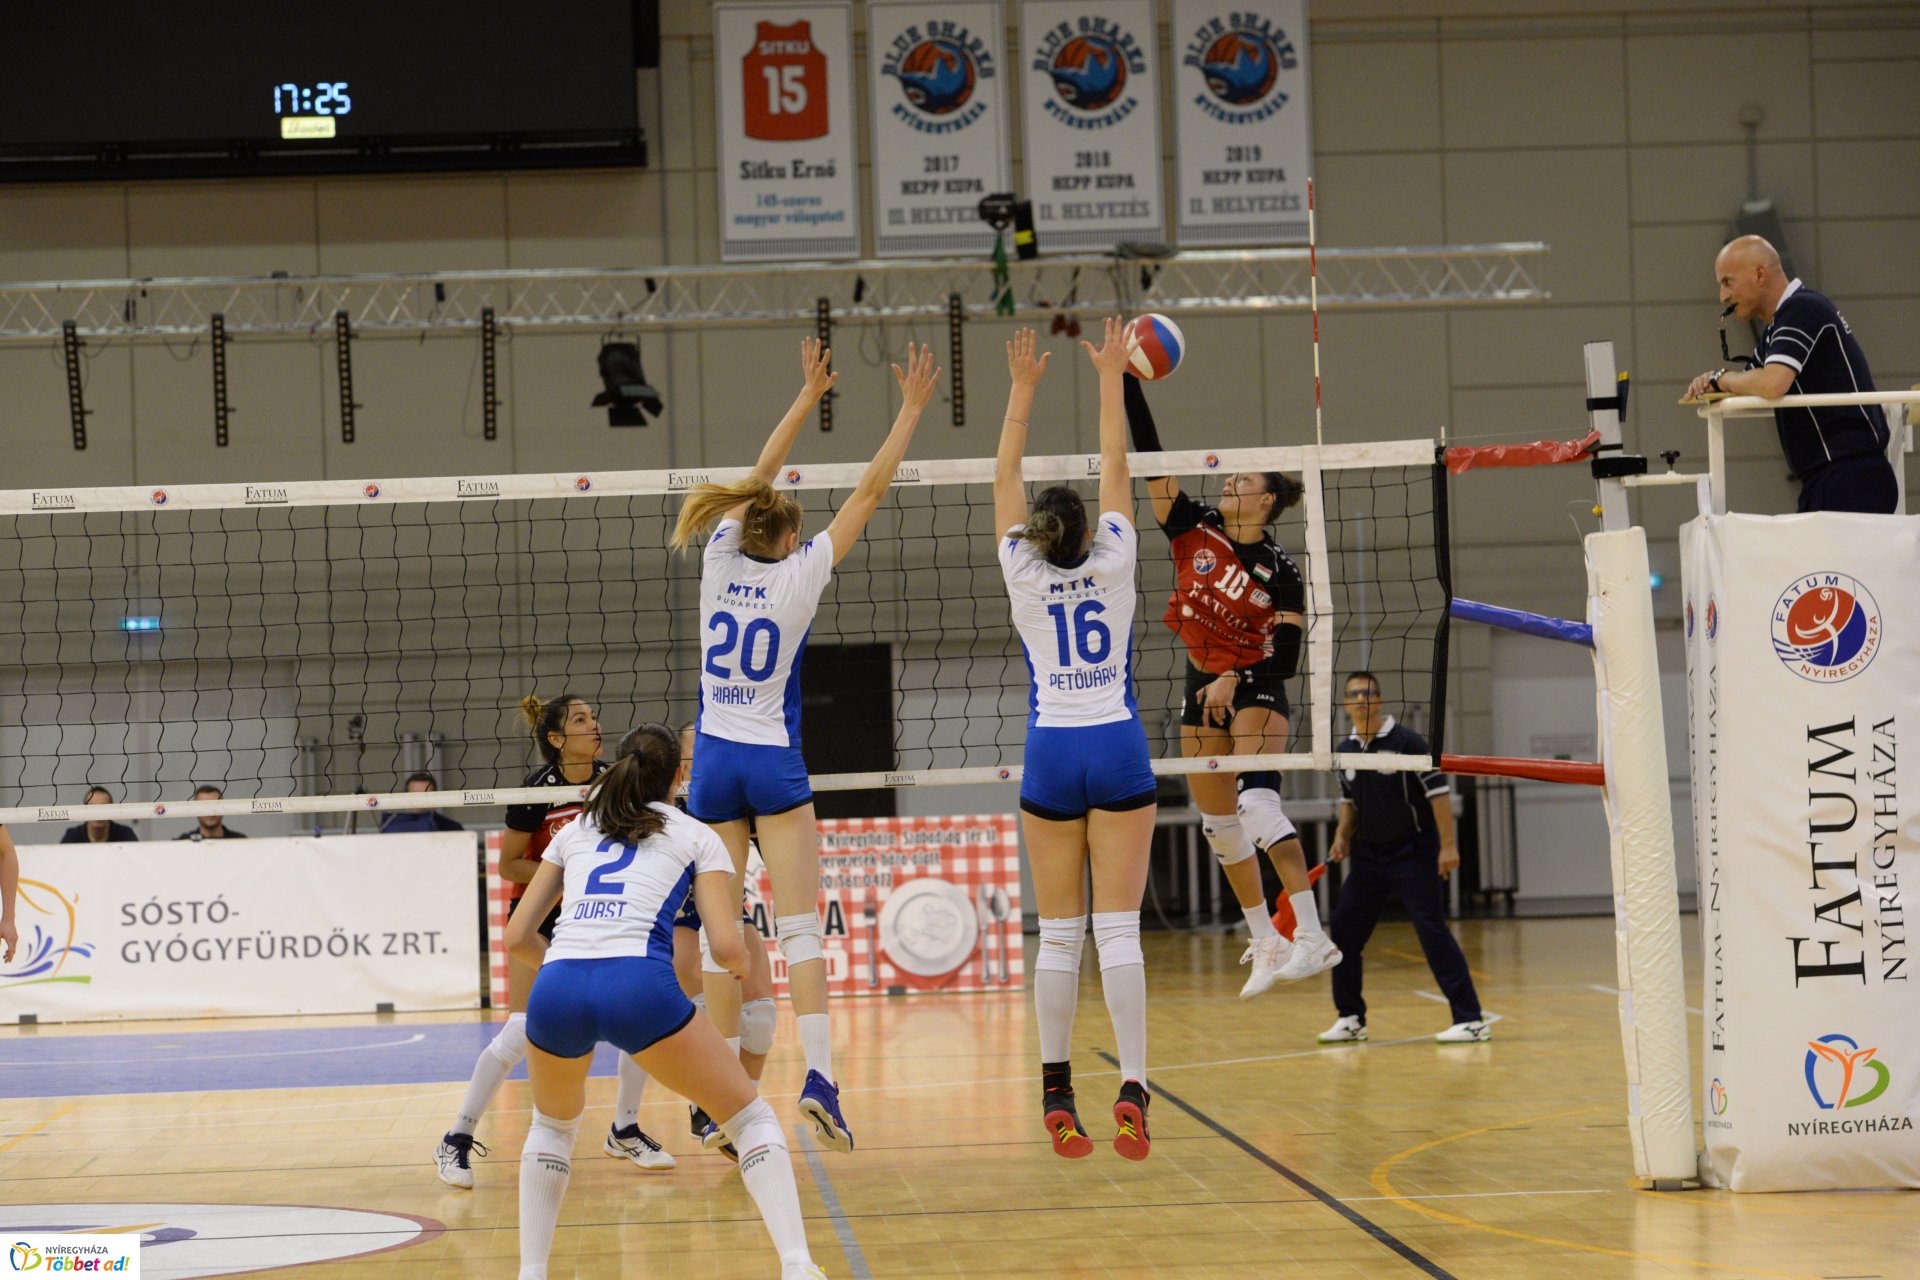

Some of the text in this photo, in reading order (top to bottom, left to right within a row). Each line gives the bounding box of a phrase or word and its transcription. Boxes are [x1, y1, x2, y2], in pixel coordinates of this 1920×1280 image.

[759, 40, 809, 55] SITKU
[881, 20, 995, 79] BLUE SHARKS
[1033, 16, 1146, 75] BLUE SHARKS
[1184, 12, 1297, 70] BLUE SHARKS
[274, 82, 351, 114] 17:25
[763, 65, 808, 115] 15
[1075, 151, 1111, 168] 2018
[1226, 145, 1262, 163] 2019
[740, 161, 786, 180] Sitku
[924, 155, 960, 173] 2017
[1052, 174, 1135, 191] HEPP KUPA
[1202, 168, 1286, 185] HEPP KUPA
[901, 178, 984, 195] HEPP KUPA
[1062, 195, 1150, 220] HELYEZÉS
[1212, 189, 1300, 214] HELYEZÉS
[911, 206, 980, 225] HELYEZ
[457, 479, 499, 492] FATUM
[668, 472, 709, 484] FATUM
[32, 492, 74, 505] FATUM
[245, 486, 287, 498] FATUM
[727, 582, 767, 599] MTK
[1050, 576, 1096, 594] MTK
[1214, 563, 1250, 601] 10
[717, 595, 774, 610] BUDAPEST
[1776, 575, 1839, 623] FATUM
[1047, 600, 1111, 667] 16
[705, 611, 780, 682] 20
[1050, 665, 1117, 691] PETŐVÁRY
[712, 685, 756, 705] KIRÁLY
[884, 773, 915, 784] FATUM
[252, 800, 283, 810] FATUM
[464, 791, 495, 801] FATUM
[38, 808, 69, 818] FATUM
[1785, 714, 1867, 989] FATUM
[1866, 714, 1908, 984] NYÍREGYHÁZA
[585, 834, 639, 895] 2
[121, 895, 240, 926] SÓSTÓ-
[574, 901, 628, 920] DURST
[121, 929, 449, 964] GYÓGYFÜRDŐK ZRT.
[1788, 1114, 1914, 1136] NYÍREGYHÁZA
